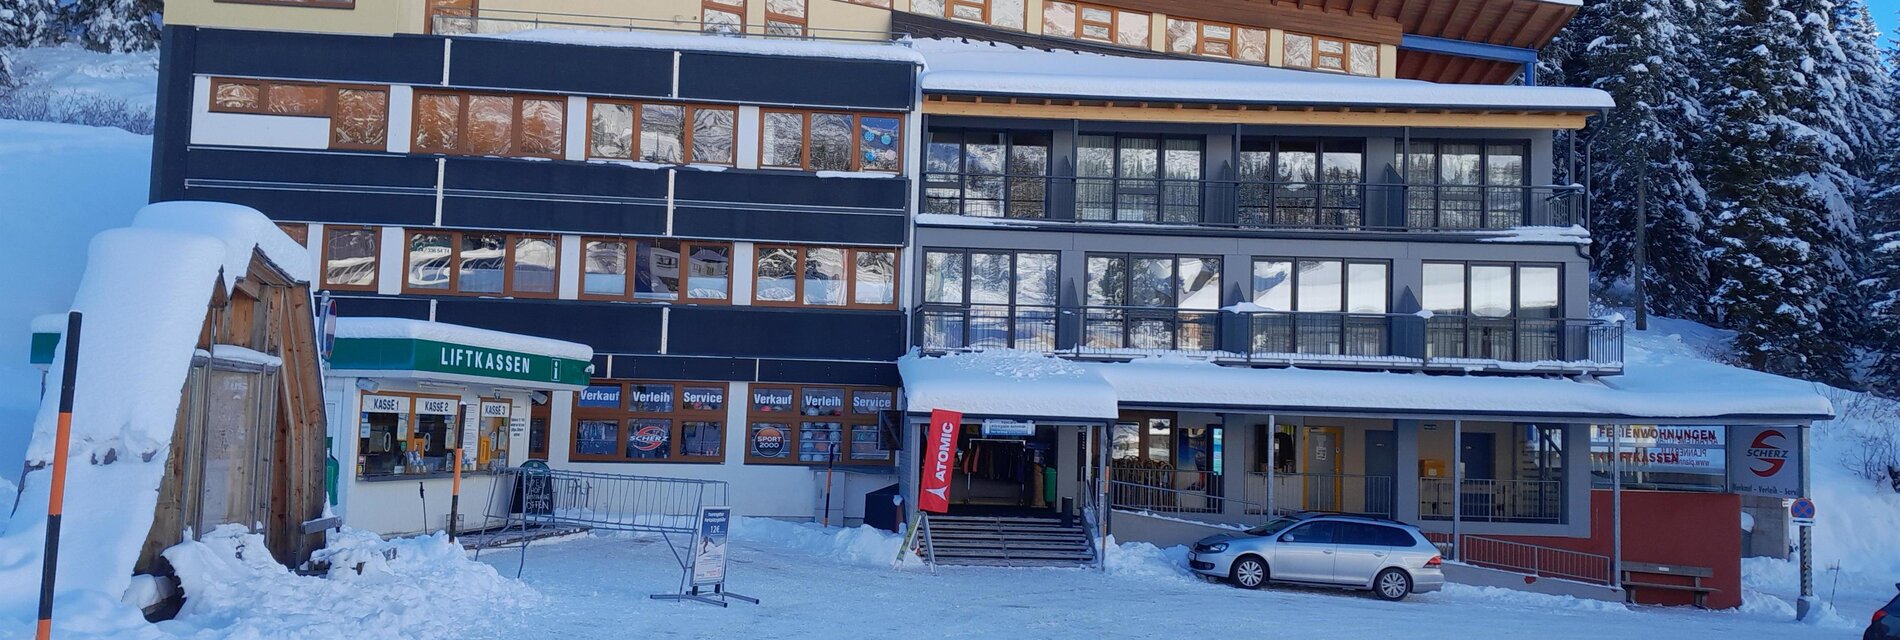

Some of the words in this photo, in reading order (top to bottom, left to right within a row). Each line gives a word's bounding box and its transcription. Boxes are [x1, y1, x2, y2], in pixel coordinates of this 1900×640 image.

[441, 347, 530, 374] LIFTKASSEN
[580, 390, 620, 401] Verkauf
[632, 391, 670, 402] Verleih
[683, 392, 723, 403] Service
[754, 393, 792, 405] Verkauf
[805, 395, 841, 407] Verleih
[373, 398, 395, 411] KASSE
[395, 401, 399, 411] 1
[424, 400, 443, 412] KASSE
[444, 401, 449, 412] 2
[853, 396, 892, 408] Service
[484, 404, 501, 415] KASSE
[501, 405, 506, 416] 3
[935, 422, 954, 482] ATOMIC
[1746, 449, 1789, 458] SCHERZ
